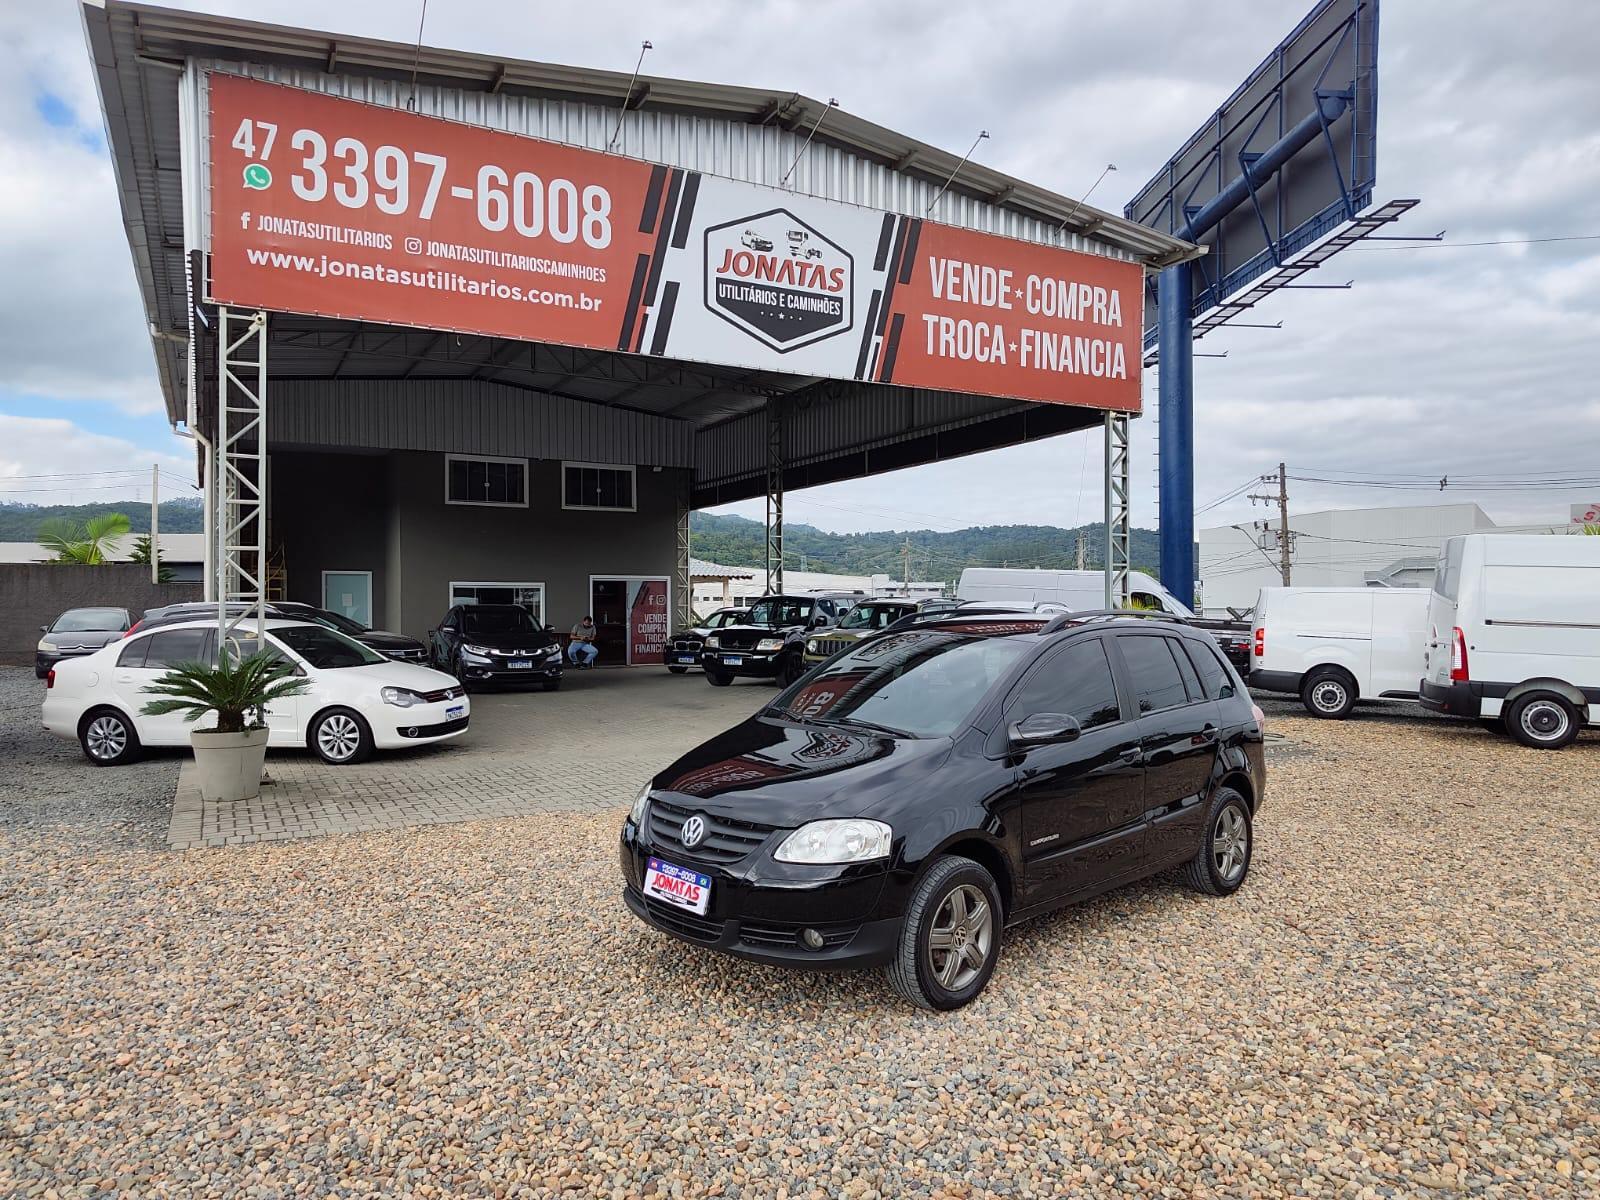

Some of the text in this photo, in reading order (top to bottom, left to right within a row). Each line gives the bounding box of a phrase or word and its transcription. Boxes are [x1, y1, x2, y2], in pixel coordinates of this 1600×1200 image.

[232, 118, 612, 250] 47 3397-6008
[257, 215, 393, 251] JONATASUTILITARIOS
[426, 241, 606, 282] JONATASUTILITARIOSCAMINHOES
[716, 248, 845, 293] JONATAS
[247, 246, 602, 312] www.jonatasutilitarios.com.br
[718, 283, 841, 317] UTILITÁRIOS E CAMINHÕES
[929, 256, 1122, 327] VENDE COMPRA
[923, 313, 1126, 380] TROCA FINANCIA
[637, 623, 667, 634] COMPRA
[644, 613, 667, 624] VENDE
[645, 633, 667, 643] TROCA
[652, 872, 701, 901] JONATAS
